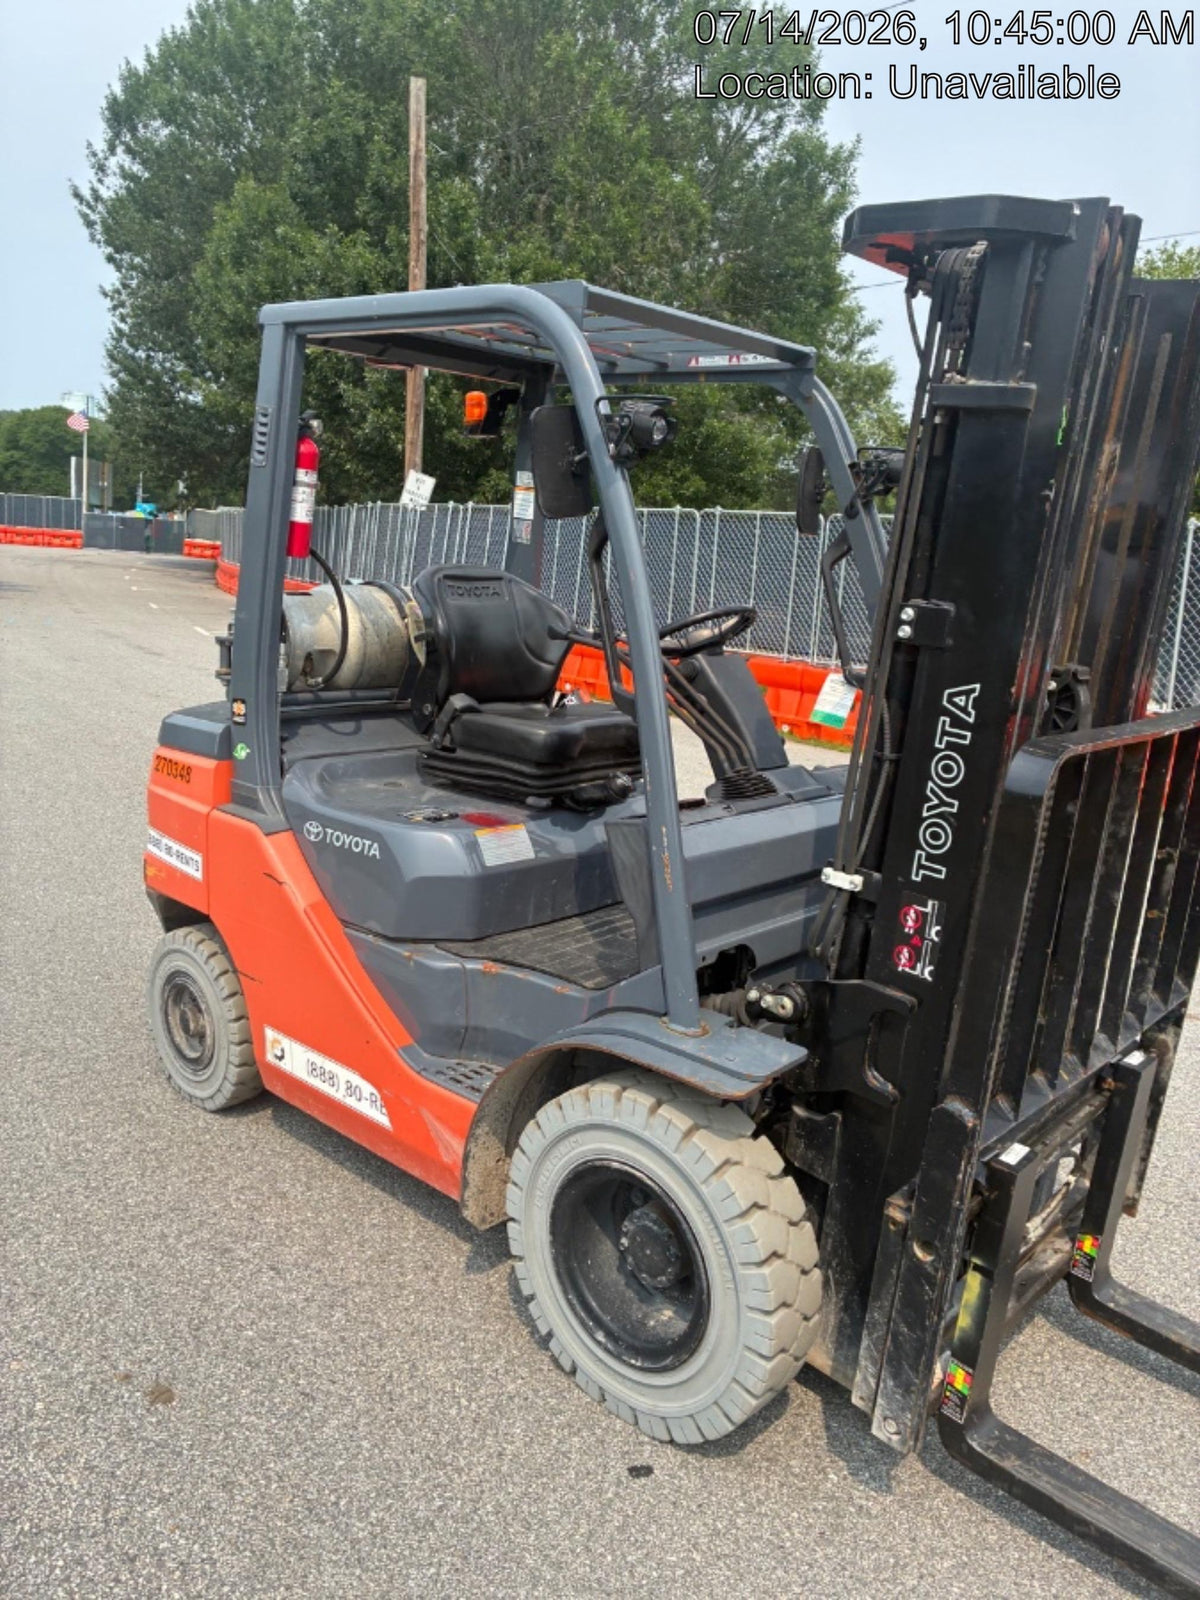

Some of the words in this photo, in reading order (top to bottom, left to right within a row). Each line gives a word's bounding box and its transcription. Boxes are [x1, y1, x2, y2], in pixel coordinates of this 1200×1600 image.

[447, 584, 501, 598] TOYOTA
[154, 754, 193, 784] 270348
[911, 683, 981, 882] TOYOTA
[324, 827, 381, 860] TOYOTA
[306, 1057, 341, 1094] (888)
